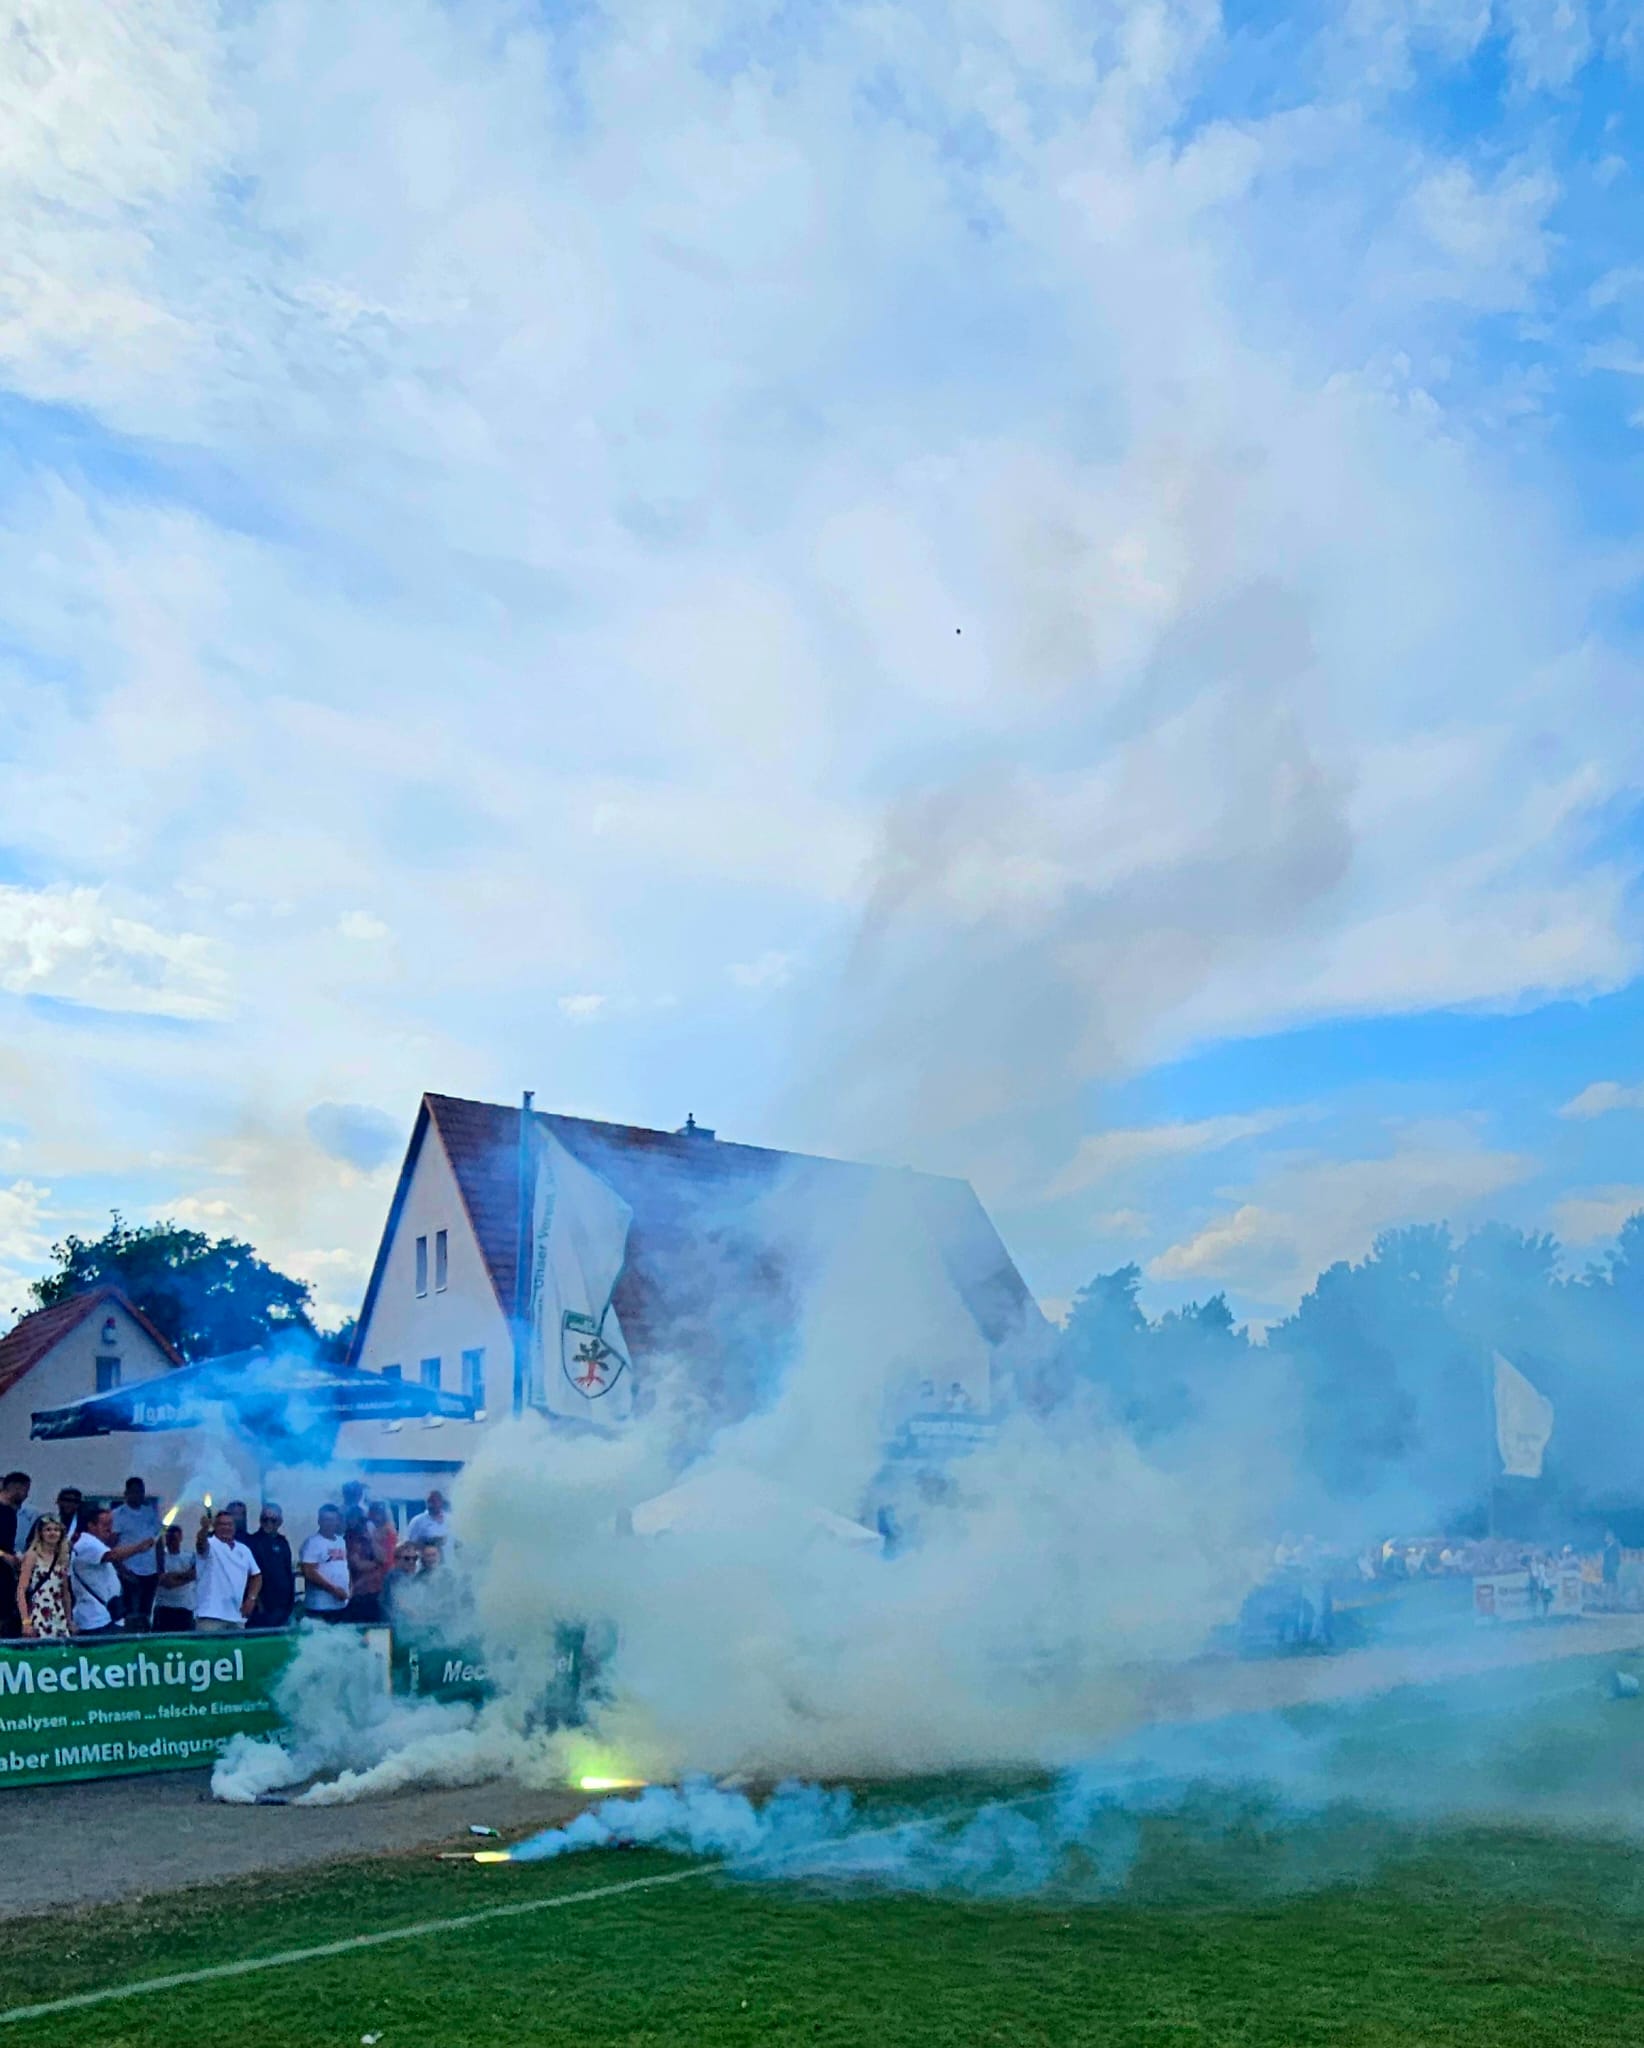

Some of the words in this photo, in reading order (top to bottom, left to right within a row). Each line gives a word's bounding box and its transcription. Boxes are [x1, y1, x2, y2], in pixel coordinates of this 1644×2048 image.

[0, 1648, 244, 1696] Meckerhügel
[158, 1703, 207, 1719] falsche
[0, 1750, 49, 1772] aber
[55, 1742, 125, 1767] IMMER
